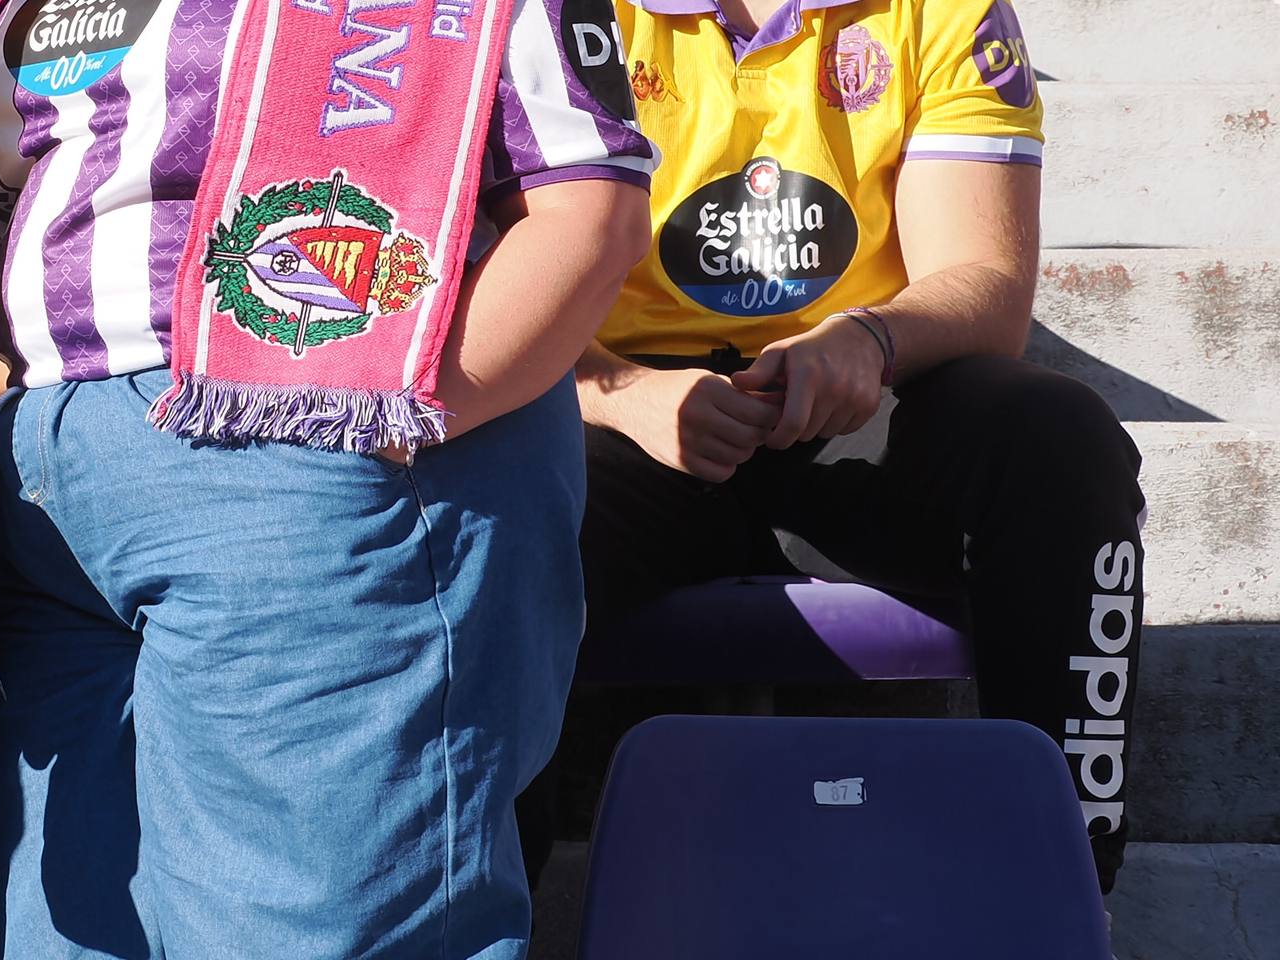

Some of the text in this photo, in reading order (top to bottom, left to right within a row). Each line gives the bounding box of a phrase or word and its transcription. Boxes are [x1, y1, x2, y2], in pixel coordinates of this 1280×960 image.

[29, 3, 128, 53] Galicia
[696, 197, 826, 238] Estrella
[699, 234, 822, 277] Galicia
[741, 274, 784, 310] 0,0
[1063, 540, 1136, 840] adidas
[830, 784, 848, 801] 87
